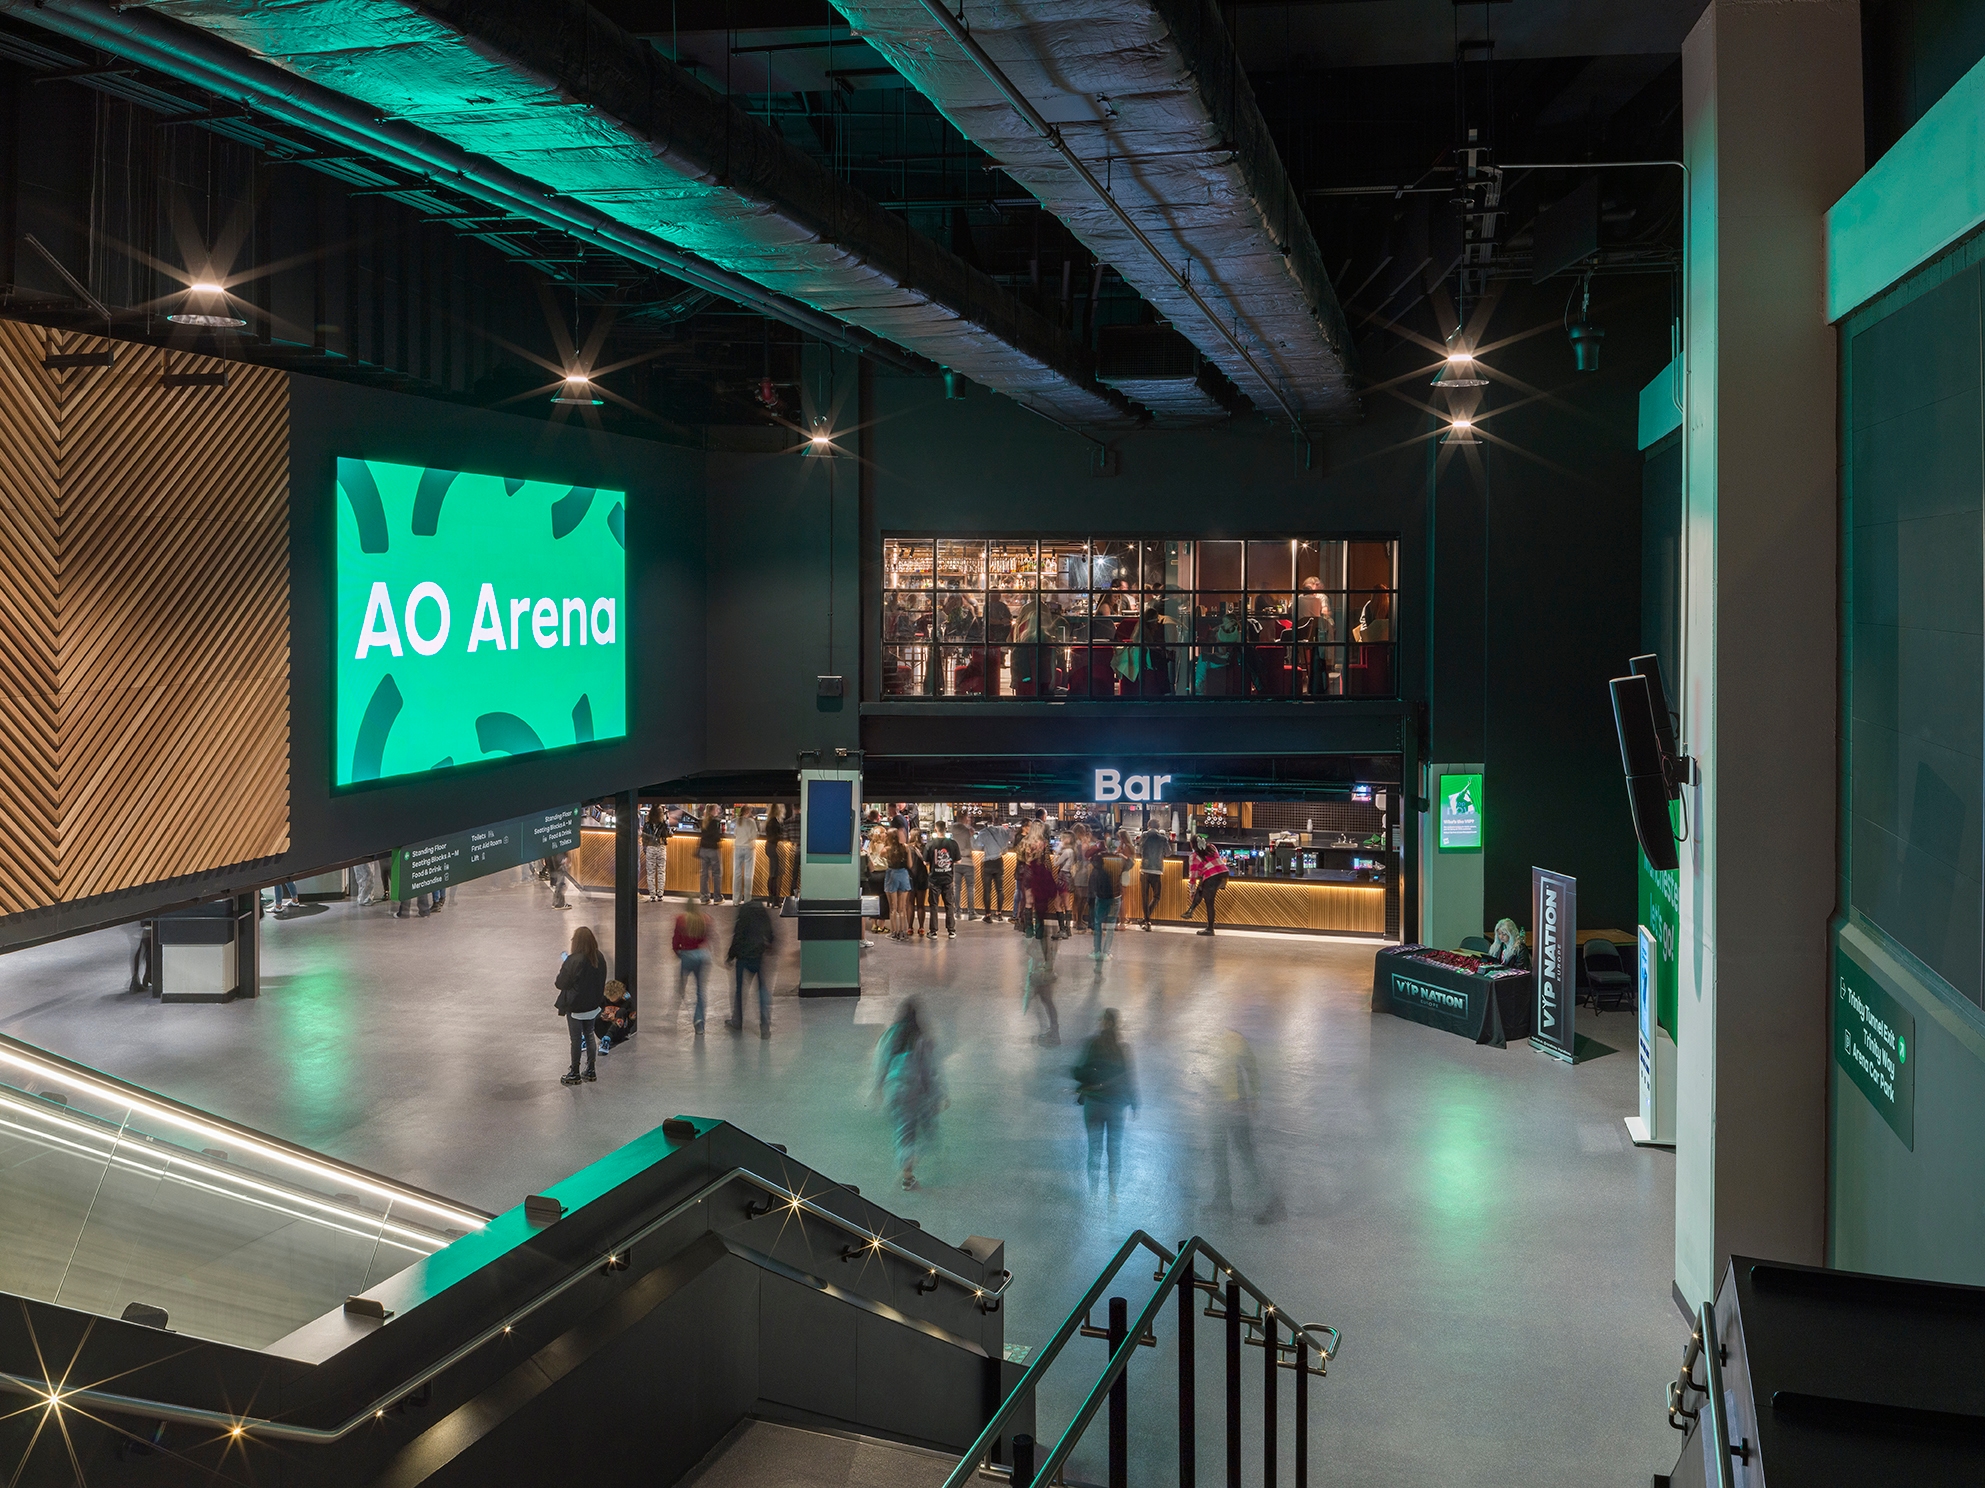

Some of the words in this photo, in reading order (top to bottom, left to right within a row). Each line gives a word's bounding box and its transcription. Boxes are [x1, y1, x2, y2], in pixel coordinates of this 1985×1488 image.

[354, 580, 450, 659] AO
[466, 582, 615, 653] Arena
[1094, 768, 1171, 801] Bar
[545, 813, 562, 822] Standing
[534, 826, 550, 834] Seating
[550, 823, 563, 831] Blocks
[471, 833, 486, 842] Toilets
[549, 832, 558, 840] Food
[412, 847, 434, 857] Standing
[471, 844, 482, 852] First
[482, 841, 490, 849] Aid
[490, 839, 502, 847] Room
[412, 857, 431, 868] Seating
[431, 854, 446, 863] Blocks
[471, 854, 480, 862] Lift
[412, 869, 424, 879] Food
[429, 865, 442, 874] Drink
[412, 876, 442, 890] Merchandise
[1545, 889, 1557, 979] NATION
[1663, 921, 1675, 962] go!
[1420, 987, 1463, 1009] NATION
[1848, 987, 1865, 1022] Trinity
[1865, 1004, 1884, 1036] Tunnel
[1883, 1020, 1896, 1050] Exit
[1863, 1028, 1881, 1066] Trinity
[1881, 1047, 1895, 1081] Way
[1852, 1042, 1868, 1073] Arena
[1868, 1061, 1881, 1085] Car
[1880, 1073, 1895, 1103] Park
